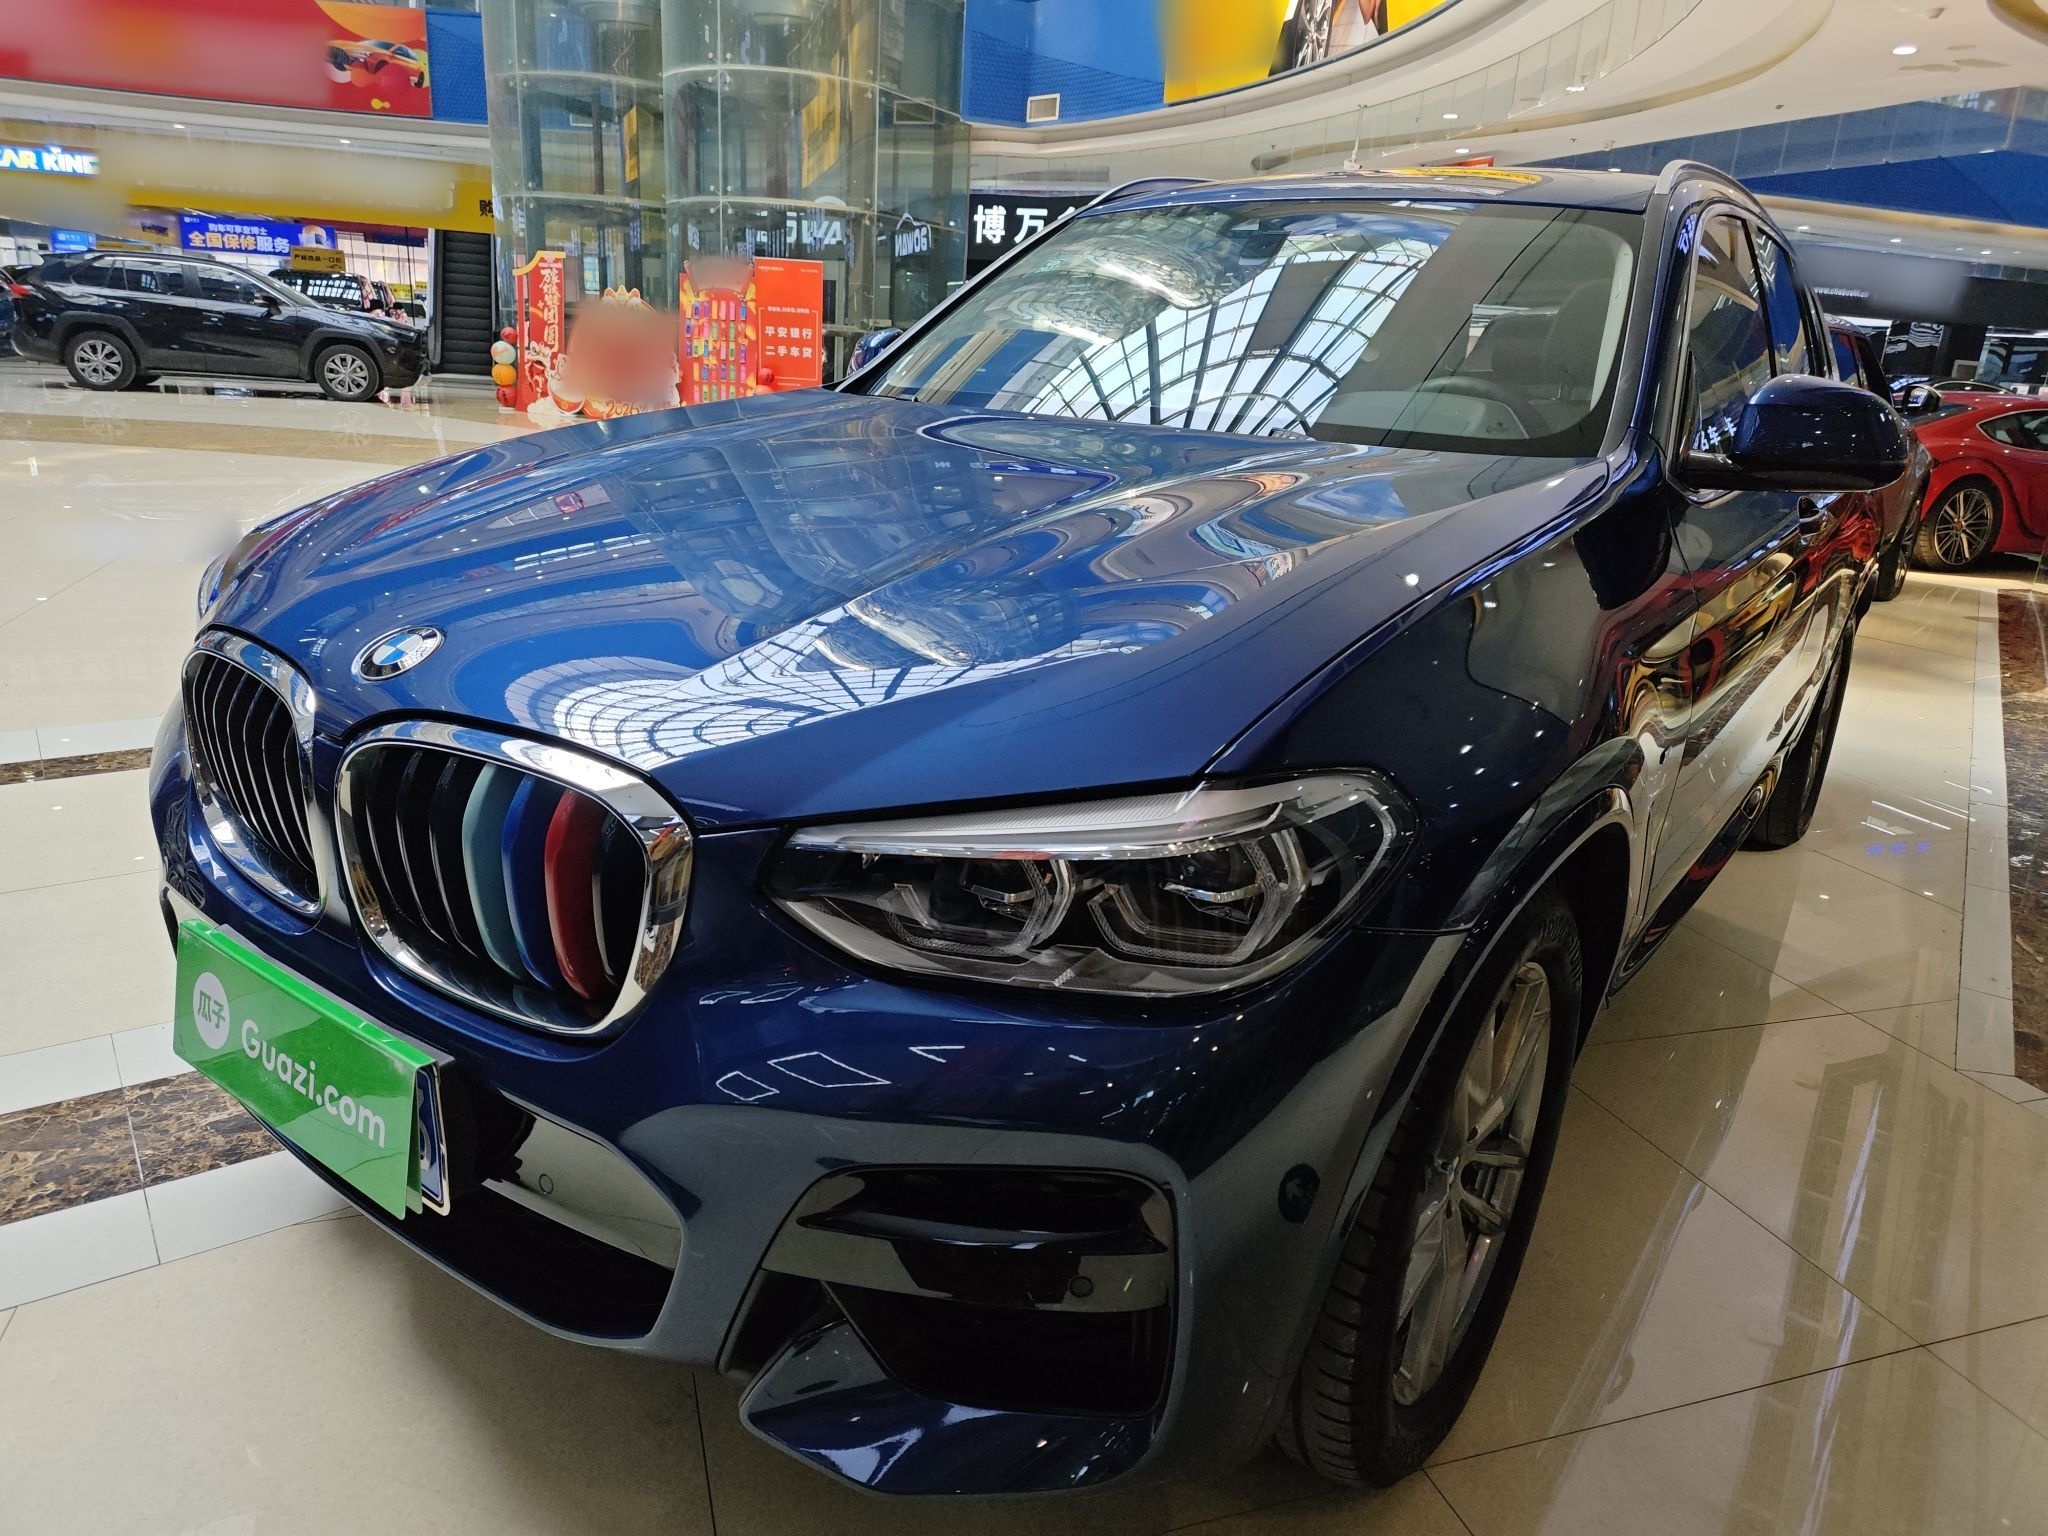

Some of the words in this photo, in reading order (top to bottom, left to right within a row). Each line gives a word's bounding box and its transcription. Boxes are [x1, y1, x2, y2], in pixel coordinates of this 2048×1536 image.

[974, 204, 1076, 245] 博万
[188, 231, 290, 253] 全国保修服务
[765, 325, 813, 340] 平安银行
[765, 345, 813, 359] 二手车贷
[604, 400, 640, 417] 2026
[198, 990, 226, 1029] 瓜子
[241, 1019, 386, 1148] Guazi.com
